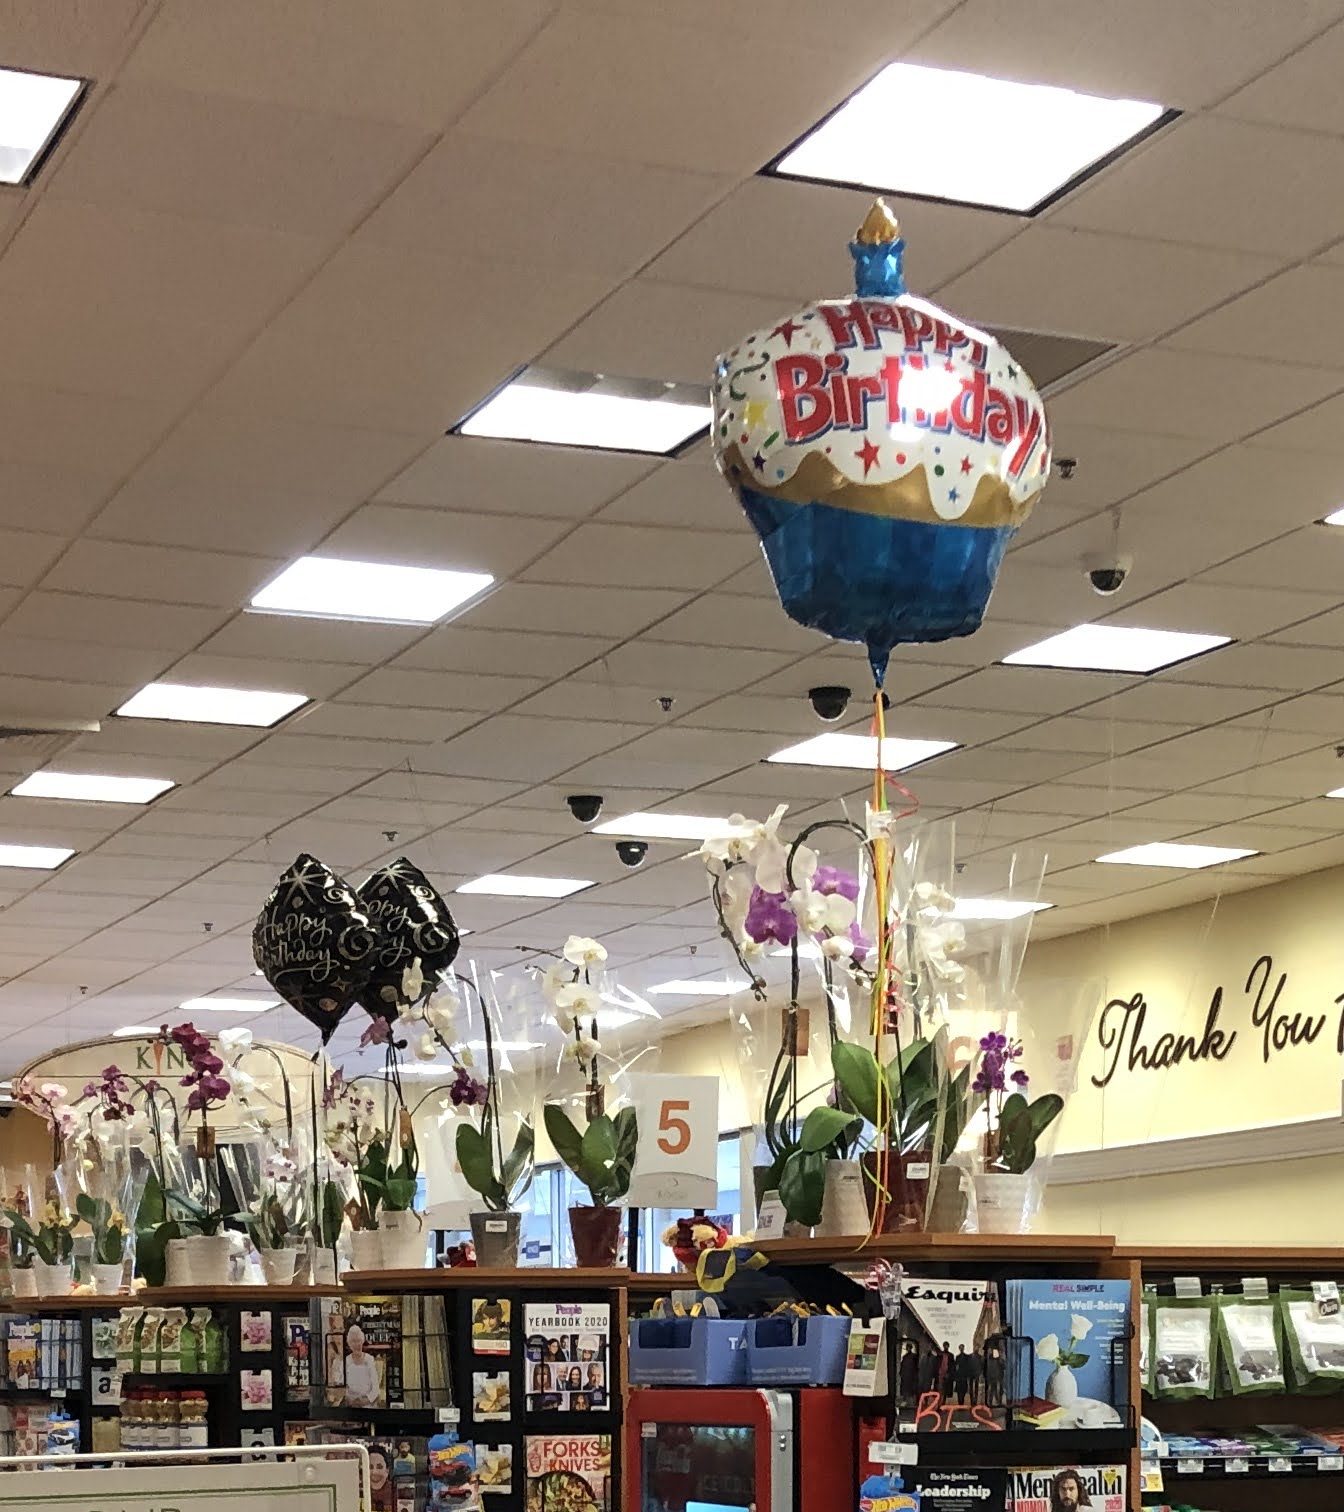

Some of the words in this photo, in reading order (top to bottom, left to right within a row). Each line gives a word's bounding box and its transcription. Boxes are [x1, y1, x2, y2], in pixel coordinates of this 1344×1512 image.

[775, 353, 1042, 478] Birtday
[258, 906, 333, 946] Happy
[1091, 986, 1237, 1088] Thank
[1245, 955, 1327, 1063] You
[657, 1100, 691, 1155] 5
[1029, 1300, 1068, 1311] Mental
[529, 1317, 580, 1326] YEARBOOK
[585, 1317, 608, 1326] 2020
[916, 1391, 1002, 1431] BTS
[543, 1441, 599, 1457] FORKS
[549, 1458, 599, 1472] KNIVES
[916, 1485, 991, 1500] Leadership
[1016, 1472, 1056, 1499] Men'
[1079, 1470, 1122, 1496] ealth
